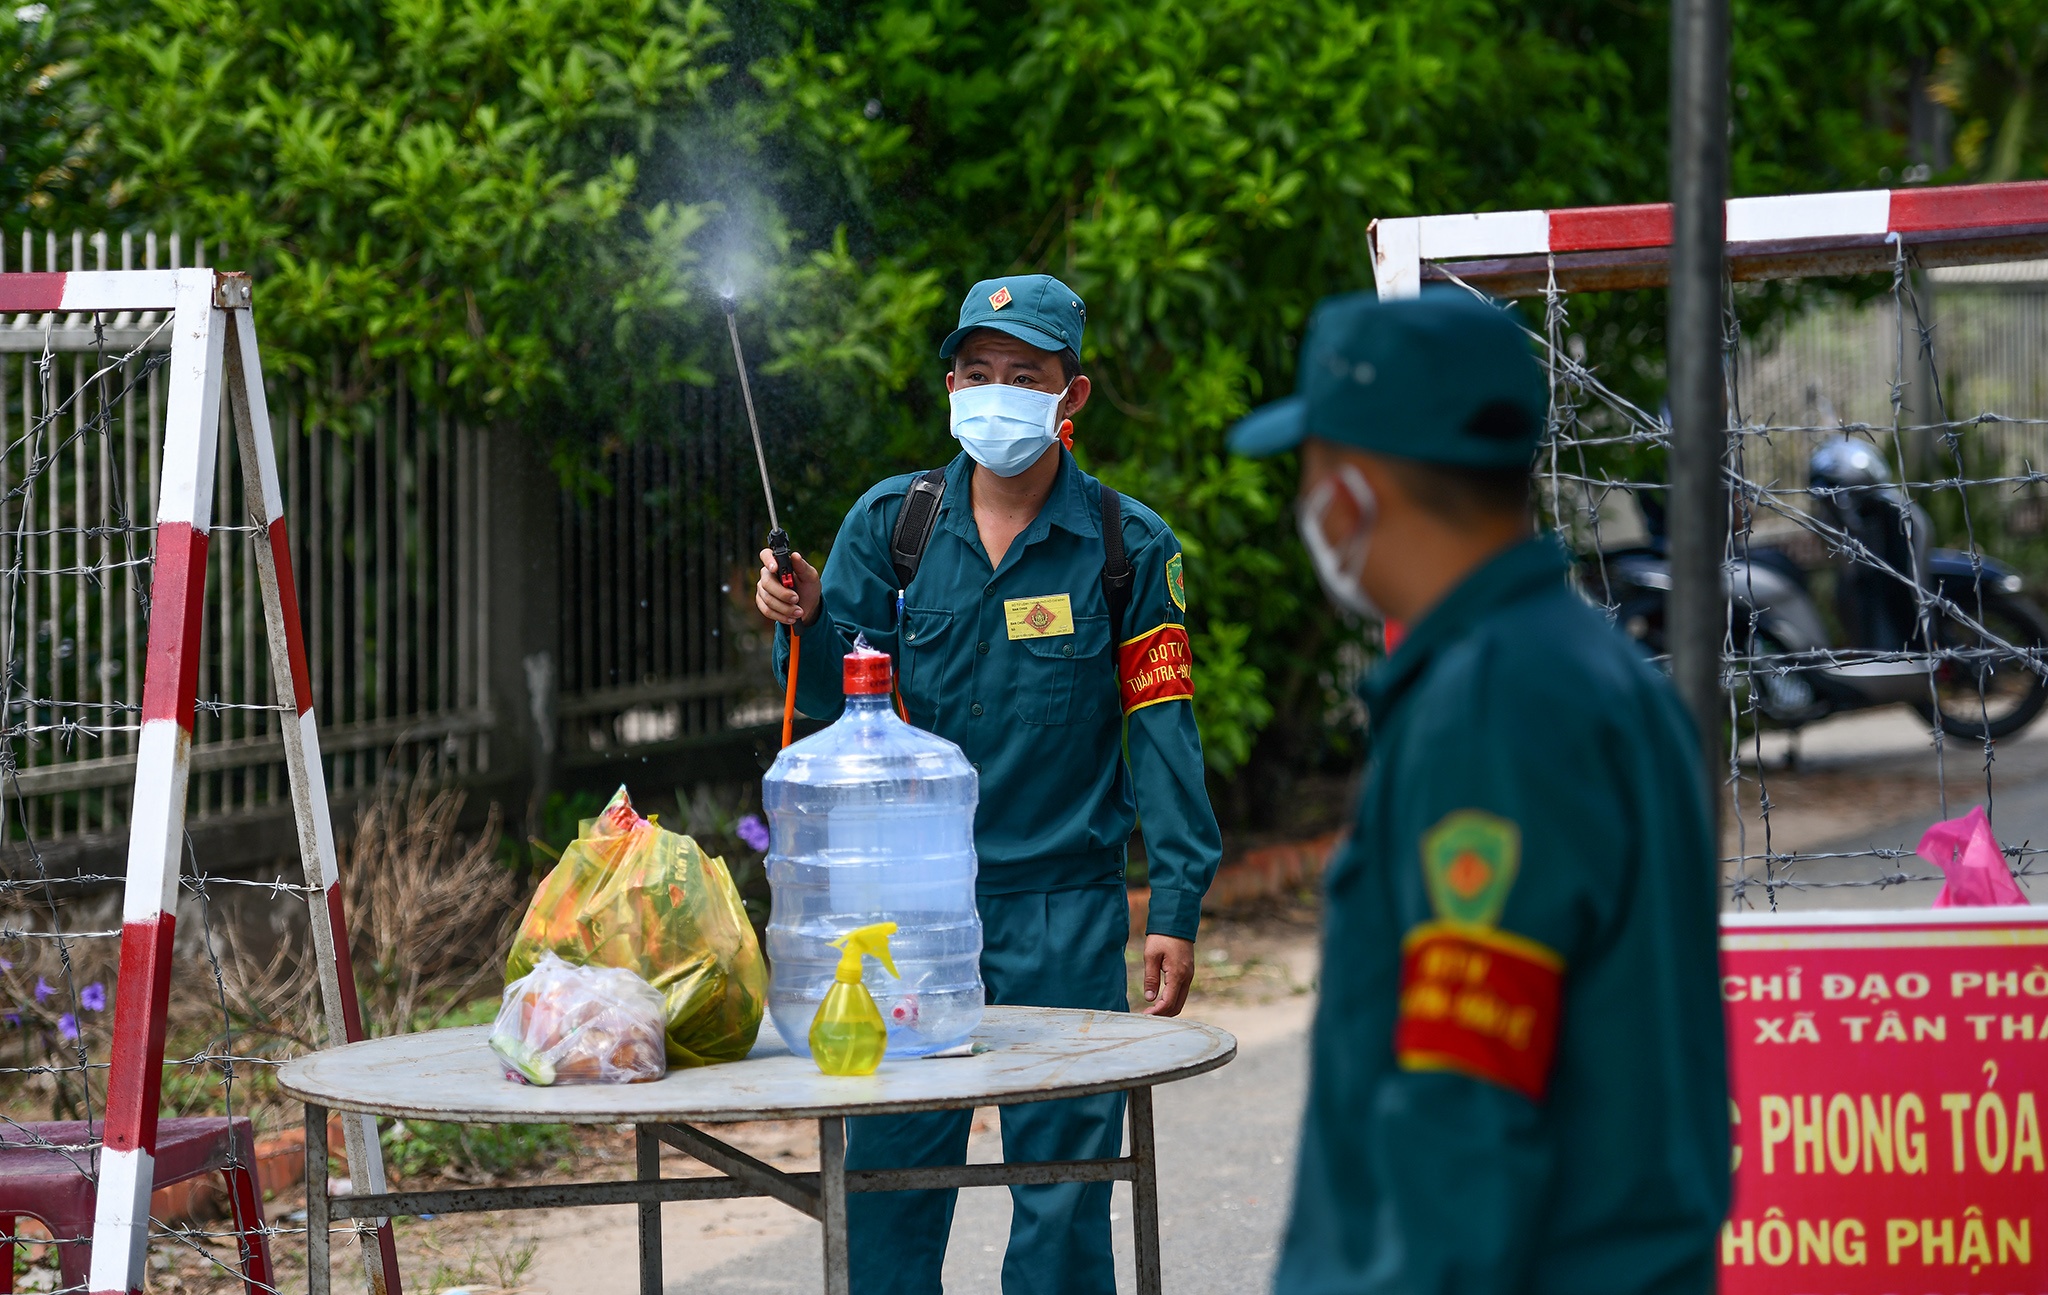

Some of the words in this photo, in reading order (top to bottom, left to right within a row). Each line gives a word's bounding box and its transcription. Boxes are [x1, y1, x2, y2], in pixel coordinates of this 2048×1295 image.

[1153, 664, 1177, 683] TRA
[1721, 966, 1802, 1002] CHỈ
[1821, 972, 1931, 1004] ĐẠO
[1754, 1010, 1820, 1044] XÃ
[1840, 1010, 1947, 1043] TÂN
[1760, 1093, 1928, 1175] PHONG
[1941, 1059, 2045, 1174] TỎA
[1886, 1205, 2031, 1275] PHẬN
